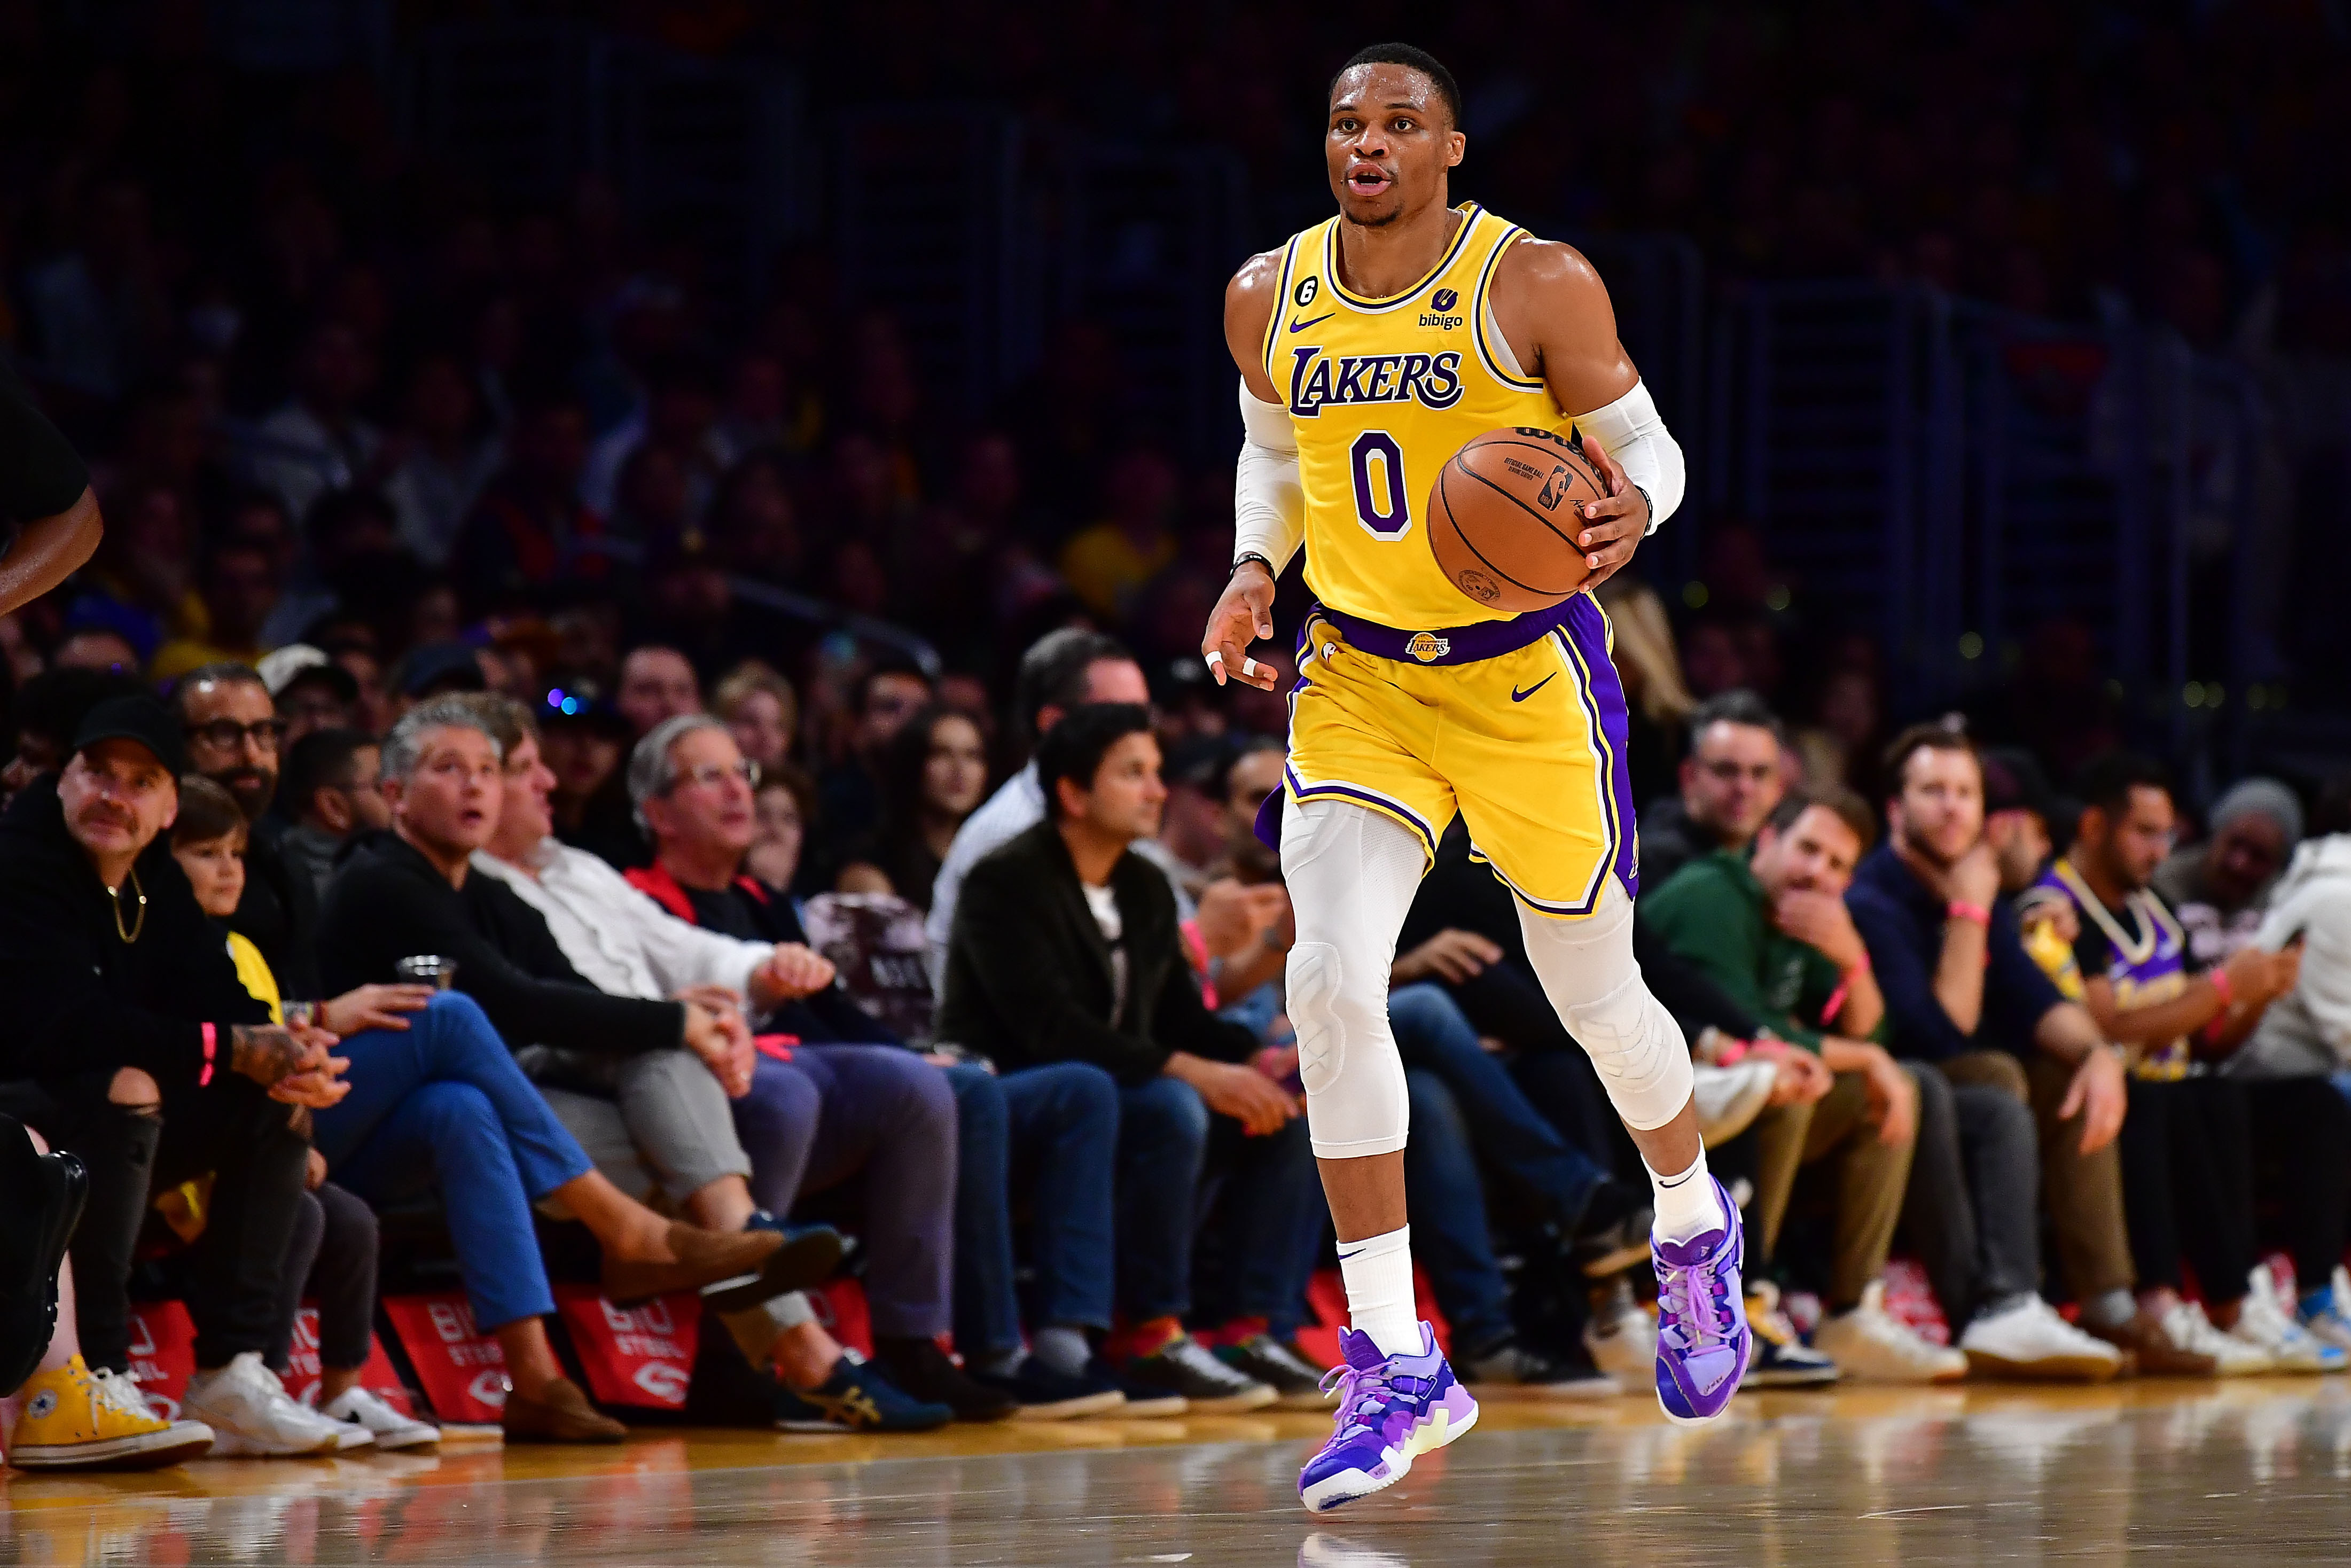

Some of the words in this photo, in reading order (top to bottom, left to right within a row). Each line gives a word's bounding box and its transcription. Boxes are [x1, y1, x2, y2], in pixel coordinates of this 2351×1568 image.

[1300, 280, 1315, 303] 6
[1419, 314, 1463, 330] bibigo
[1288, 346, 1465, 418] LAKERS
[1504, 457, 1523, 468] OFFICIAL
[1521, 463, 1535, 474] GAME
[1533, 469, 1544, 479] BALL
[1349, 430, 1412, 542] 0
[1407, 639, 1449, 654] LAKERS
